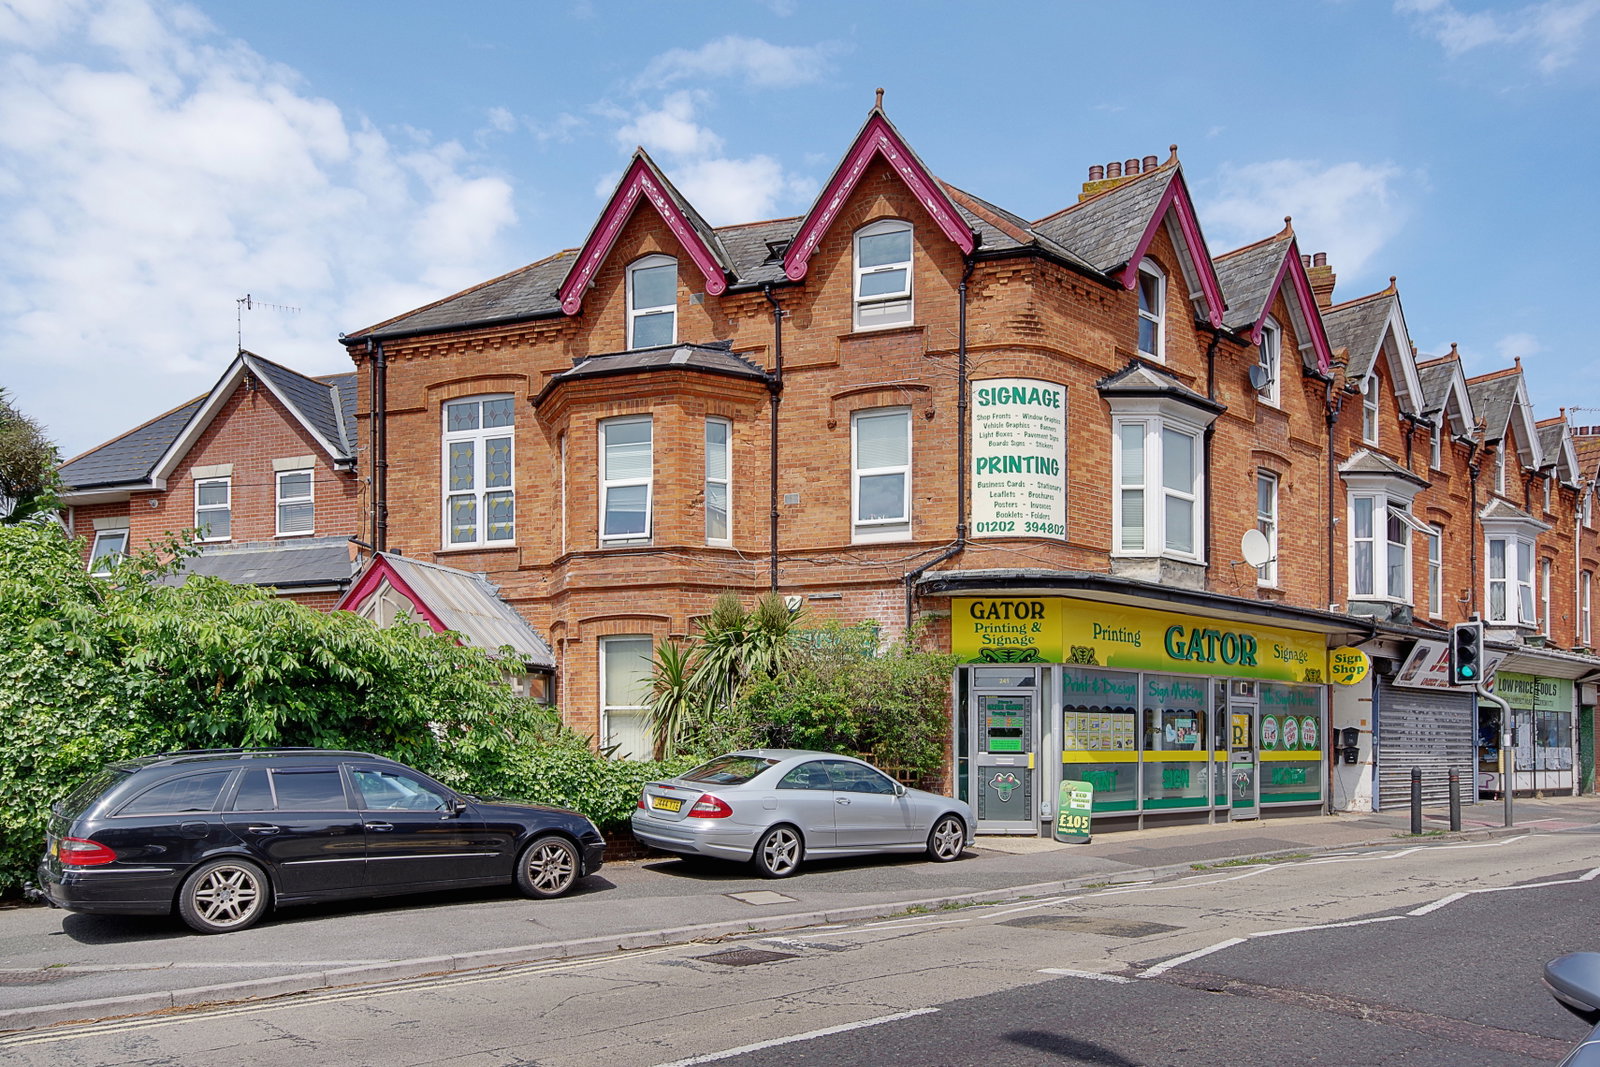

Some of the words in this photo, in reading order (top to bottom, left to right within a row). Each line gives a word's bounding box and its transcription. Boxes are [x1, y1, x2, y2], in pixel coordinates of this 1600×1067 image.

[978, 387, 1060, 409] SIGNAGE
[1044, 415, 1061, 425] Graphics
[1040, 424, 1056, 432] Banners
[1024, 431, 1048, 439] Pavement
[1036, 441, 1053, 450] Stickers
[976, 455, 1059, 476] PRINTING
[1028, 491, 1054, 500] Brochures
[1030, 502, 1051, 510] Invoices
[1030, 512, 1050, 520] Folders
[976, 521, 1015, 533] 01202
[1024, 521, 1064, 535] 394802
[970, 602, 1045, 620] GATOR
[974, 622, 1026, 634] Printing
[1031, 622, 1042, 633] &
[982, 634, 1035, 646] Signage
[1093, 622, 1141, 647] Printing
[1164, 625, 1258, 667] GATOR
[1273, 644, 1308, 664] Signage
[1335, 654, 1362, 664] Sign
[1333, 665, 1364, 674] Shop
[1063, 673, 1090, 693] Print
[1101, 678, 1135, 701] Design
[1499, 678, 1513, 692] LOW
[1514, 680, 1533, 694] PRICE
[1149, 681, 1169, 703] Sign
[1171, 682, 1204, 705] Making
[1059, 815, 1089, 828] £105
